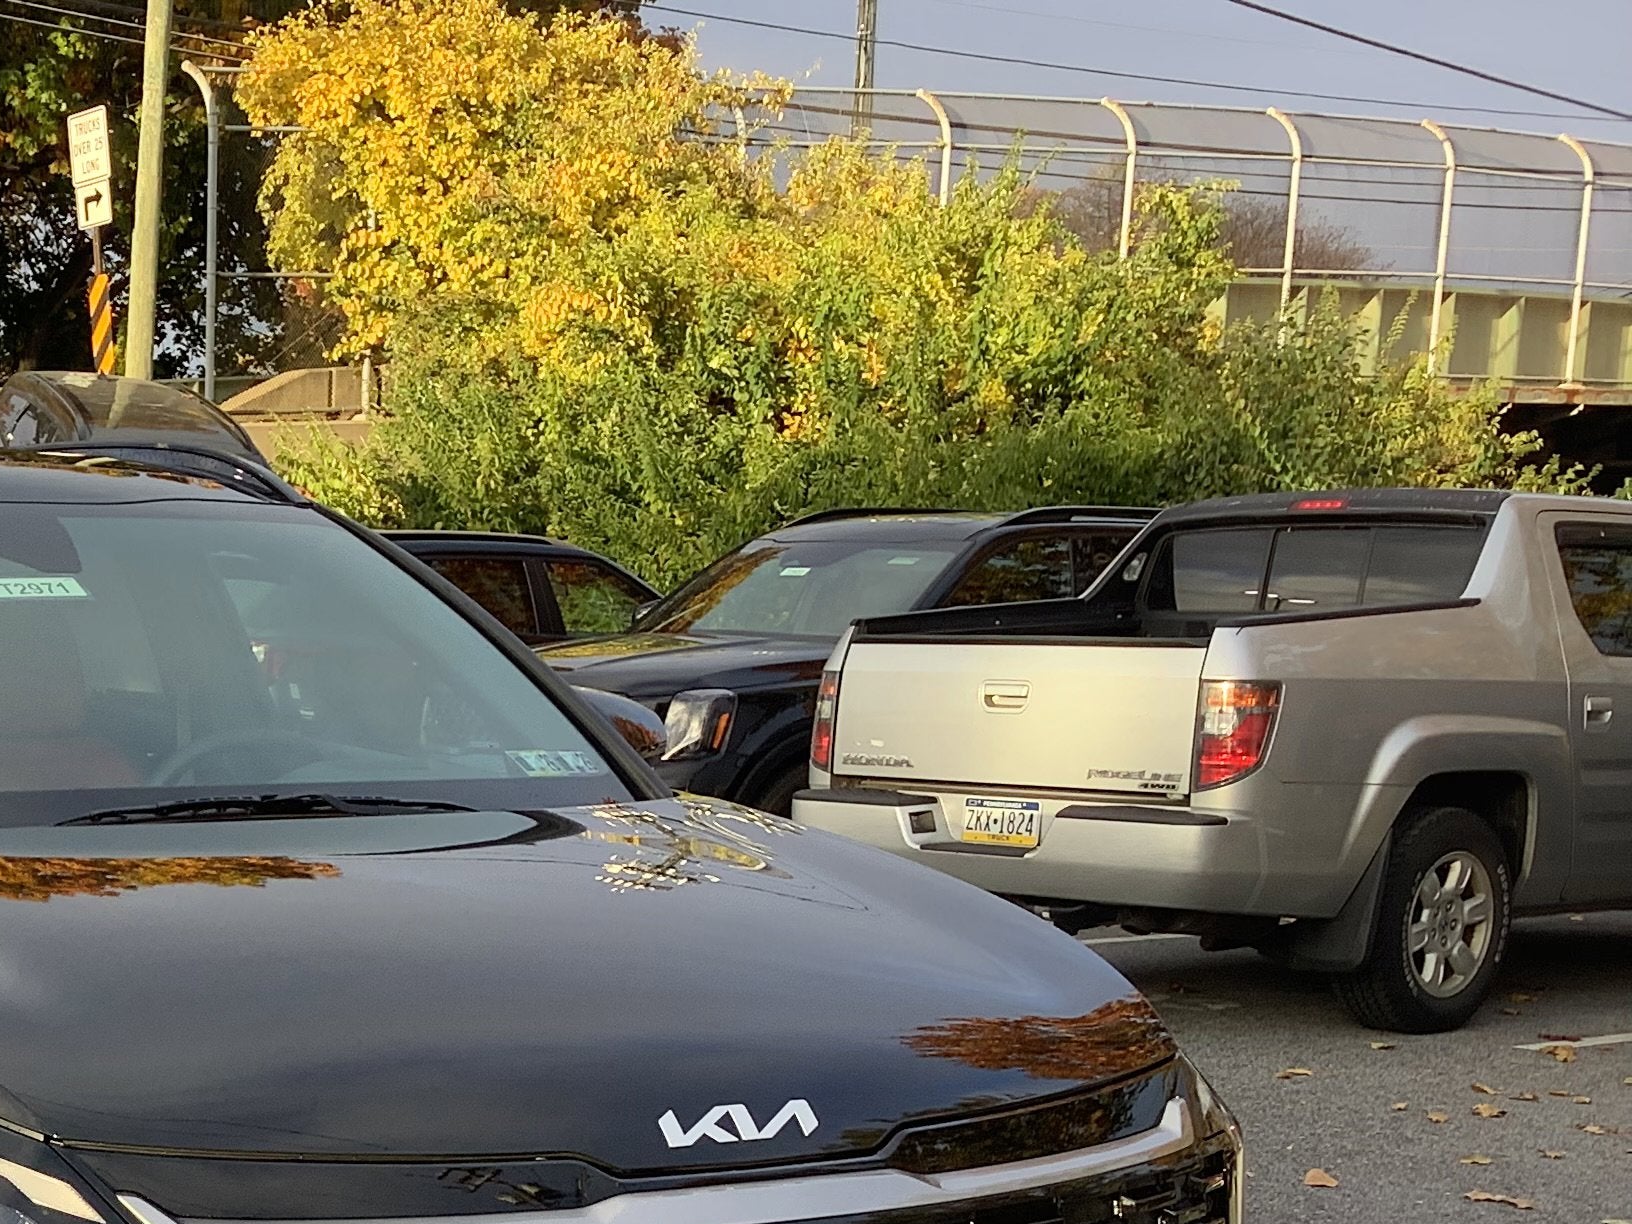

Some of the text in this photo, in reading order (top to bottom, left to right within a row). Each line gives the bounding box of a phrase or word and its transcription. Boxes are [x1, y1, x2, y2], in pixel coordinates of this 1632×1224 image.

[74, 118, 100, 137] TRUCKS
[73, 141, 91, 158] OVER
[81, 158, 100, 175] LONG
[841, 753, 915, 769] HONDA
[1138, 782, 1180, 792] 4WD
[657, 1098, 820, 1149] KIA
